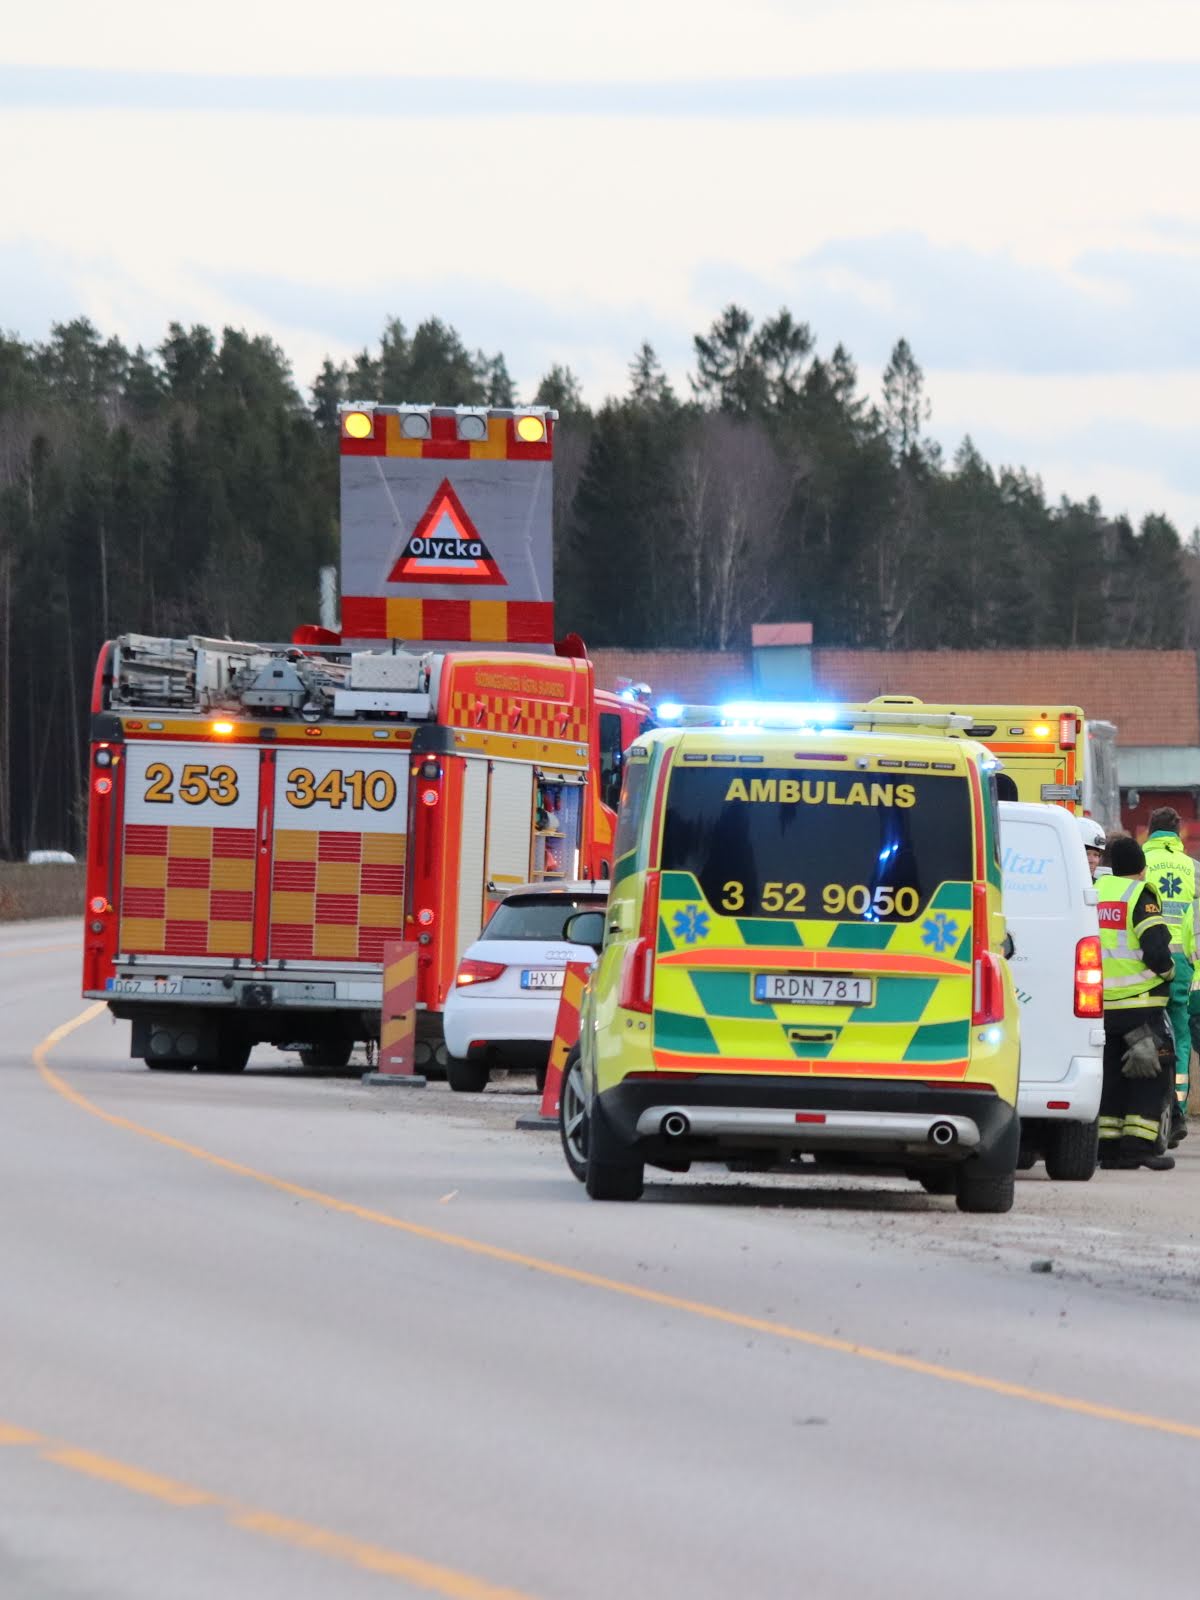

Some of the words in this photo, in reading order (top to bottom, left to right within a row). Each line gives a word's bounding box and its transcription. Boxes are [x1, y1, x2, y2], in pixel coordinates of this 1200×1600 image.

[410, 537, 482, 559] Olycka
[286, 767, 397, 811] 3410
[725, 778, 916, 808] AMBULANS
[1149, 862, 1191, 876] AMBULANS
[721, 880, 745, 911] 3
[760, 882, 806, 912] 52
[822, 883, 920, 917] 9050
[530, 972, 557, 985] HXY
[773, 978, 814, 997] RDN
[822, 980, 861, 999] 781
